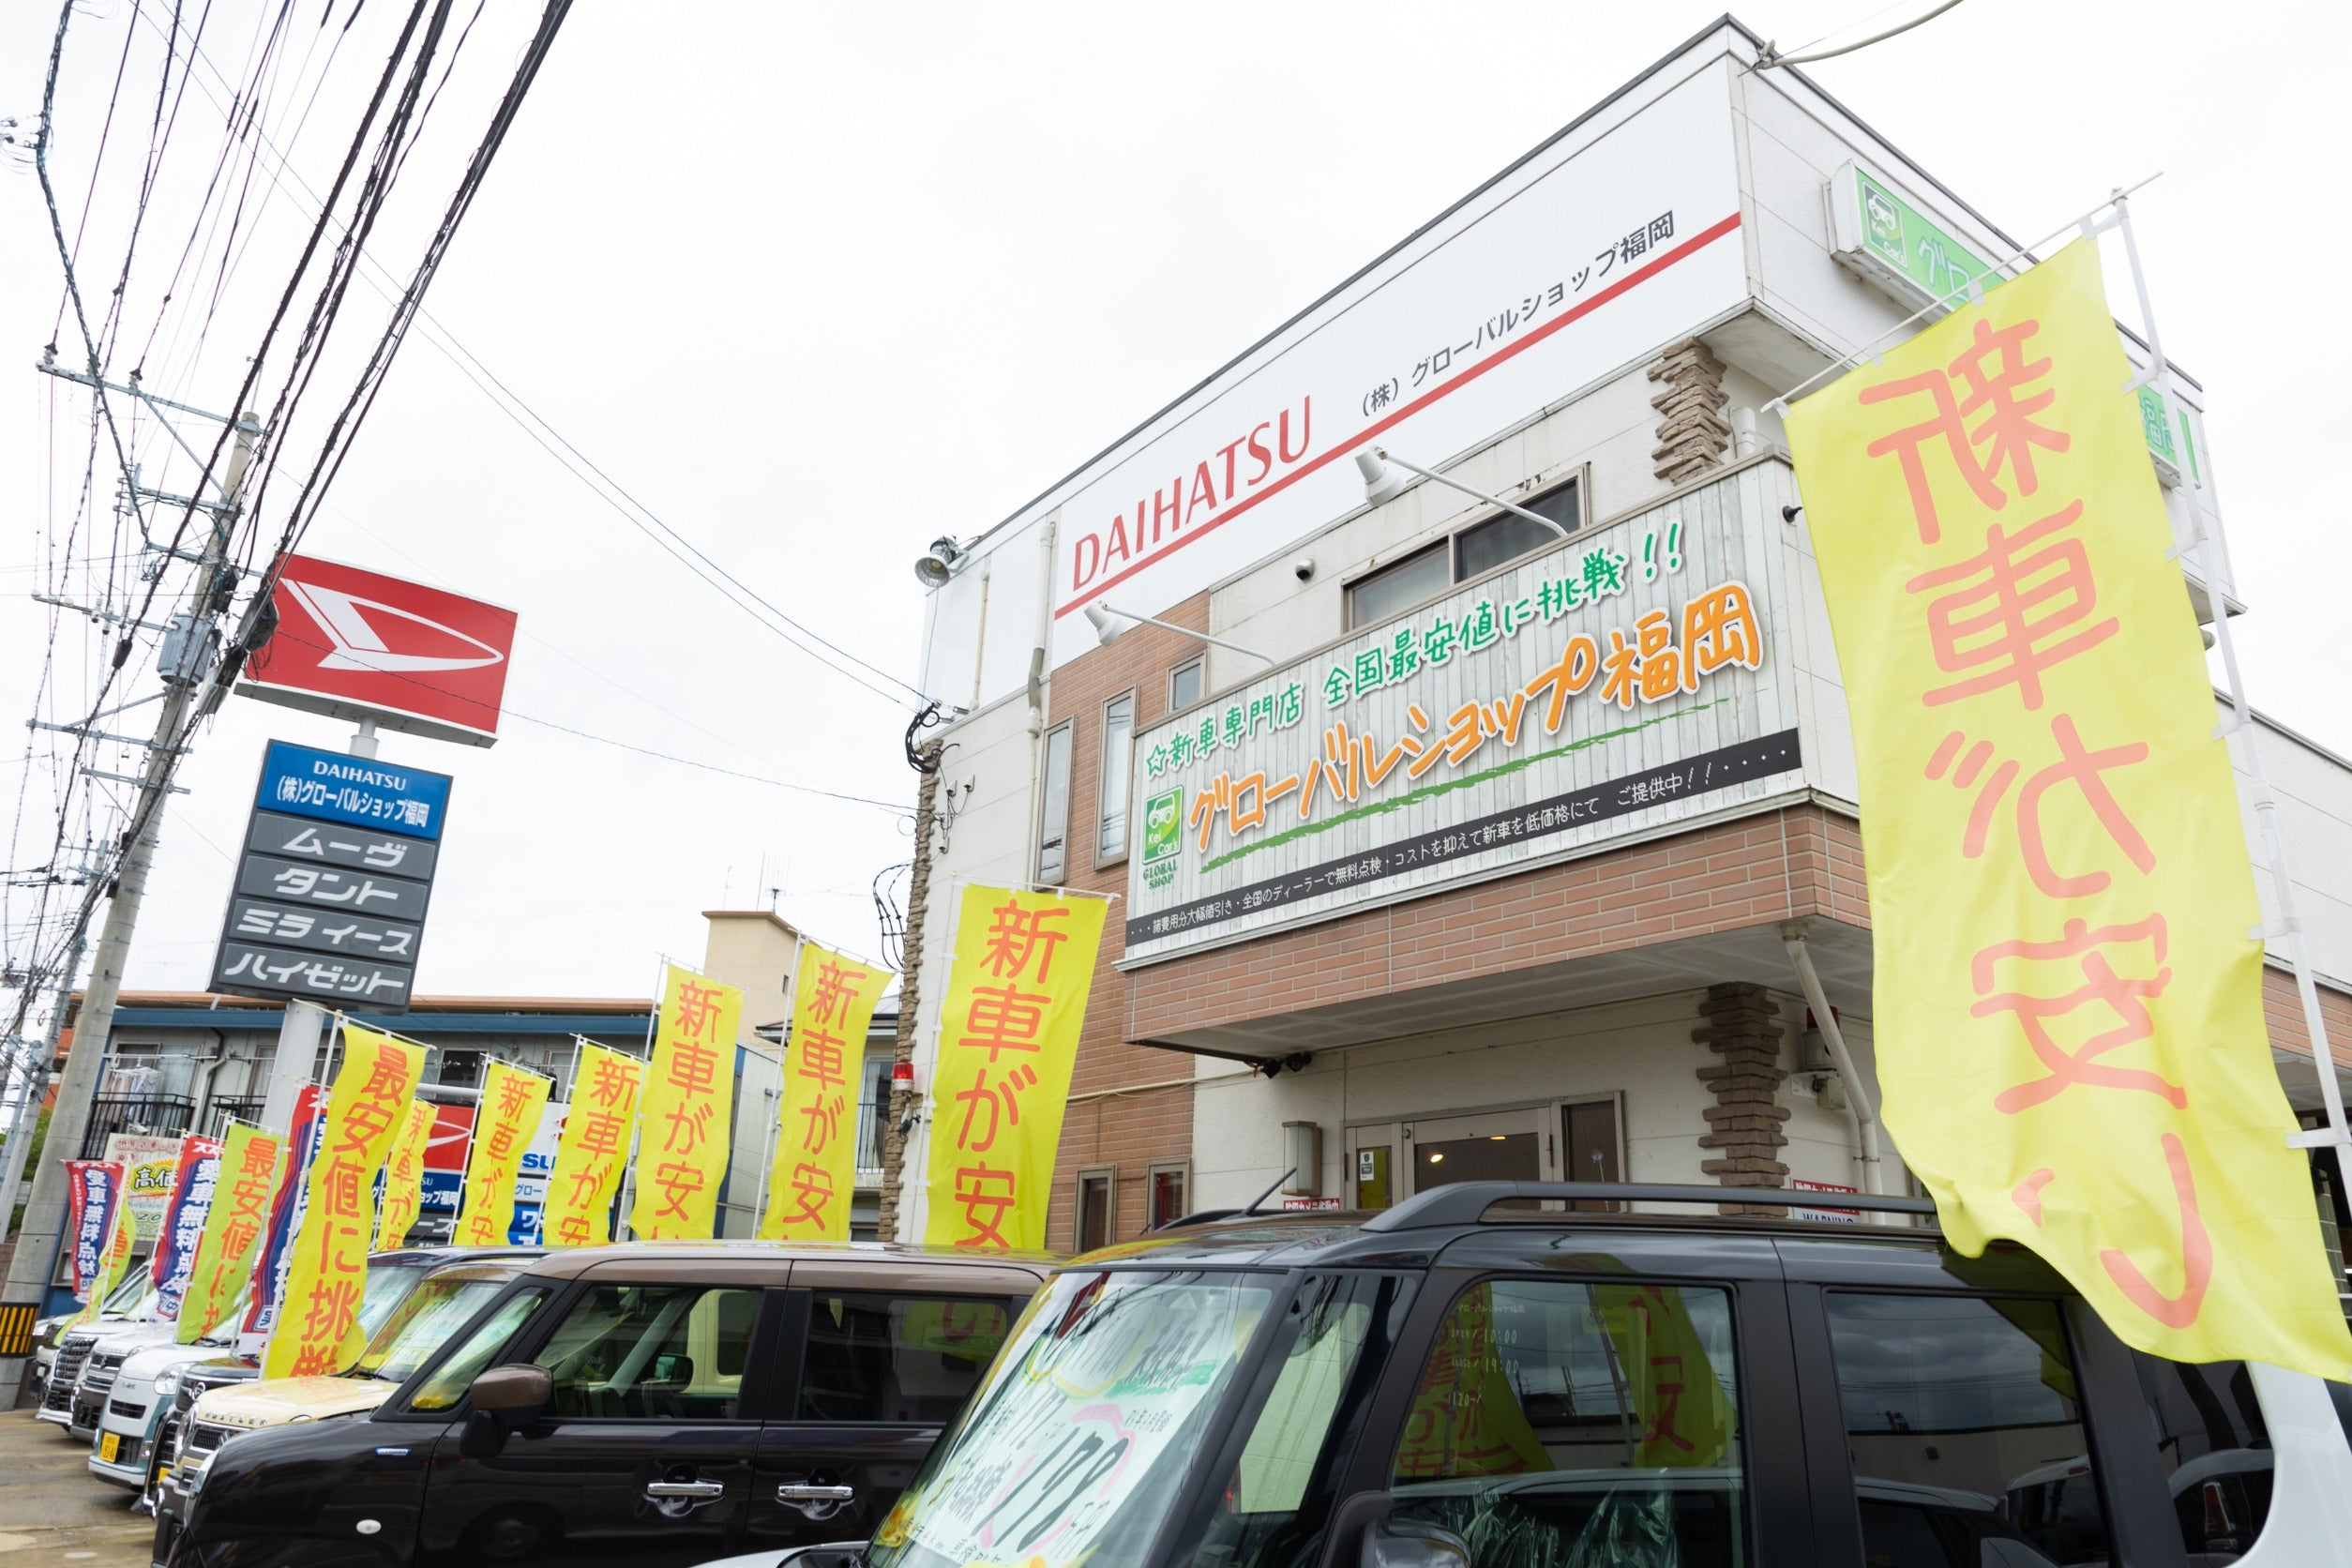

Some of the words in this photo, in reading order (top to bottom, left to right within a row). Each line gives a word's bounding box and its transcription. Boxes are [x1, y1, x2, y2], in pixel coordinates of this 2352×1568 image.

[1072, 395, 1312, 592] DAIHATSU
[1189, 584, 1761, 852] グローバルショップ福岡
[313, 760, 407, 792] DAIHATSU
[282, 828, 408, 868] ムーヴ
[1148, 829, 1162, 846] Kei
[1157, 837, 1178, 855] Car's
[273, 867, 399, 907] タント
[1143, 859, 1178, 881] GLOBAL
[1149, 874, 1174, 890] SHOP
[224, 952, 405, 995] ハイゼット
[651, 979, 723, 1240] 新車が安
[782, 959, 868, 1240] 新車が安
